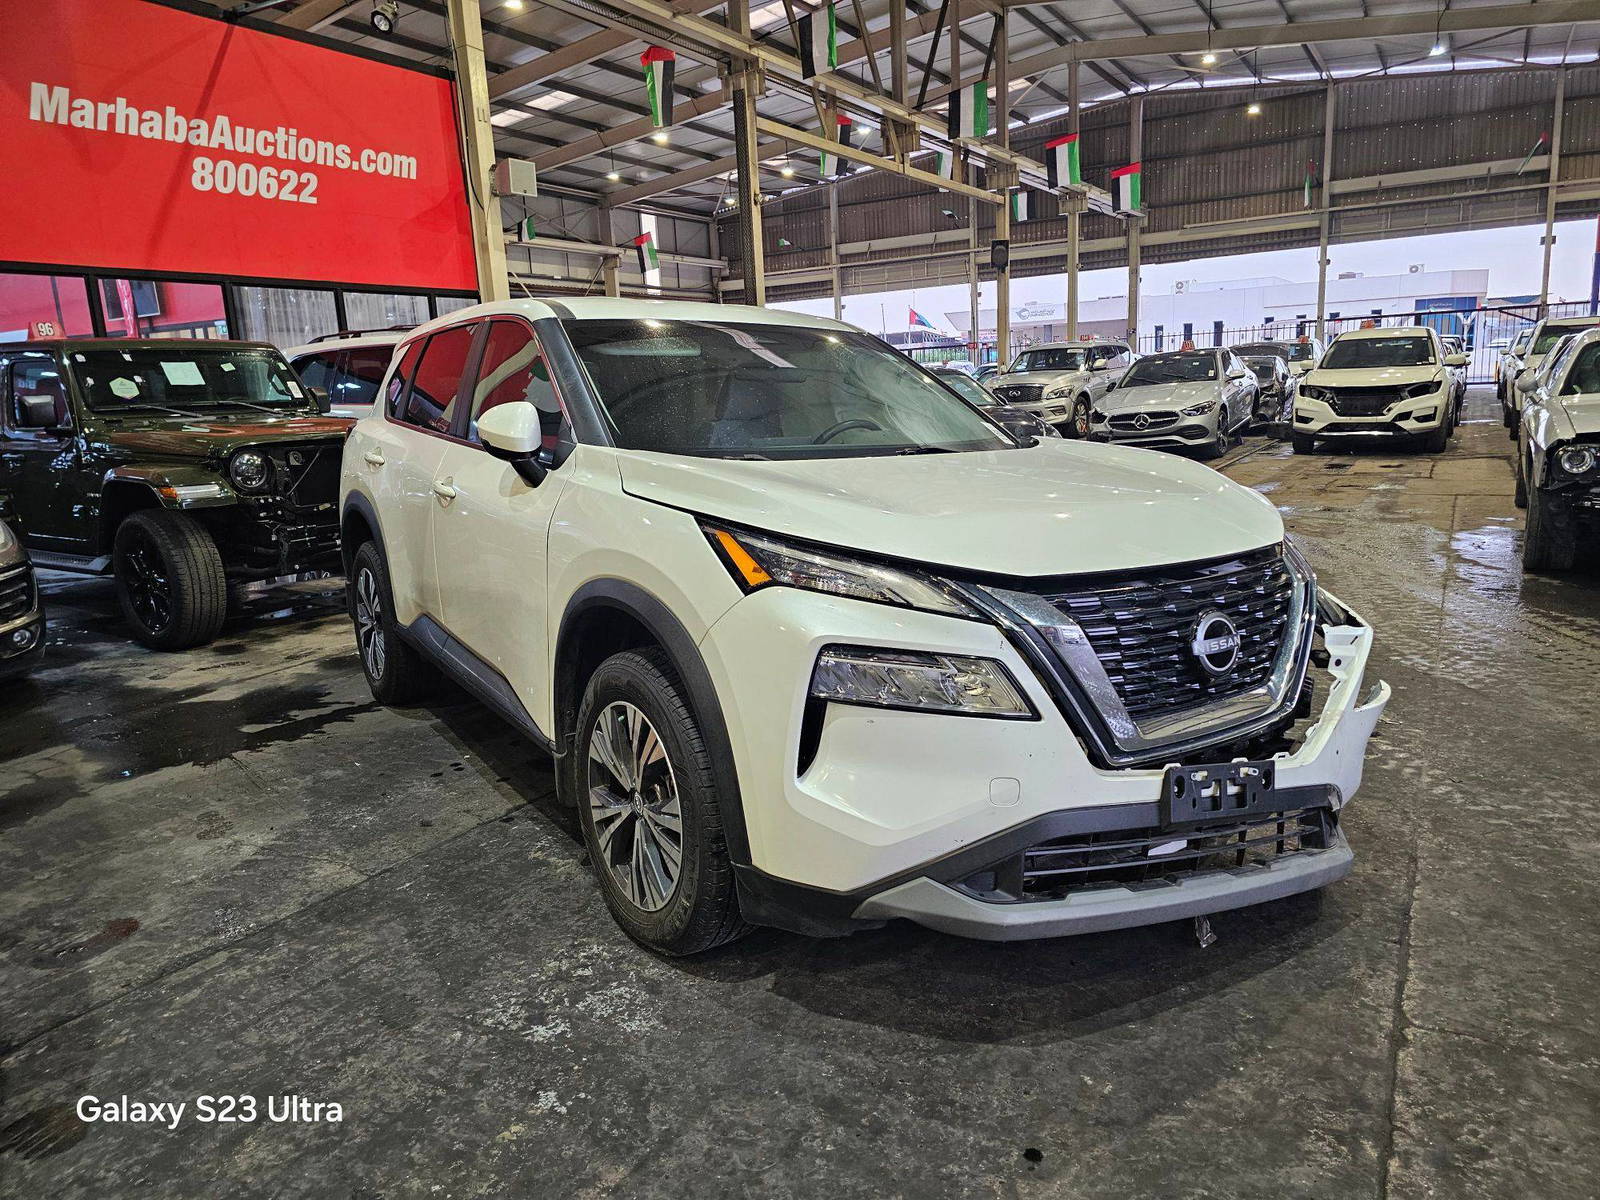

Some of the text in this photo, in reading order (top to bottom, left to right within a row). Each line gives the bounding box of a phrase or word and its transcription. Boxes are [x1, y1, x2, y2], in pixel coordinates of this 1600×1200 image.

[29, 81, 418, 180] MarhabaAuctions.com
[191, 156, 319, 205] 800622
[37, 322, 54, 336] 96
[1196, 635, 1240, 653] NISSAN
